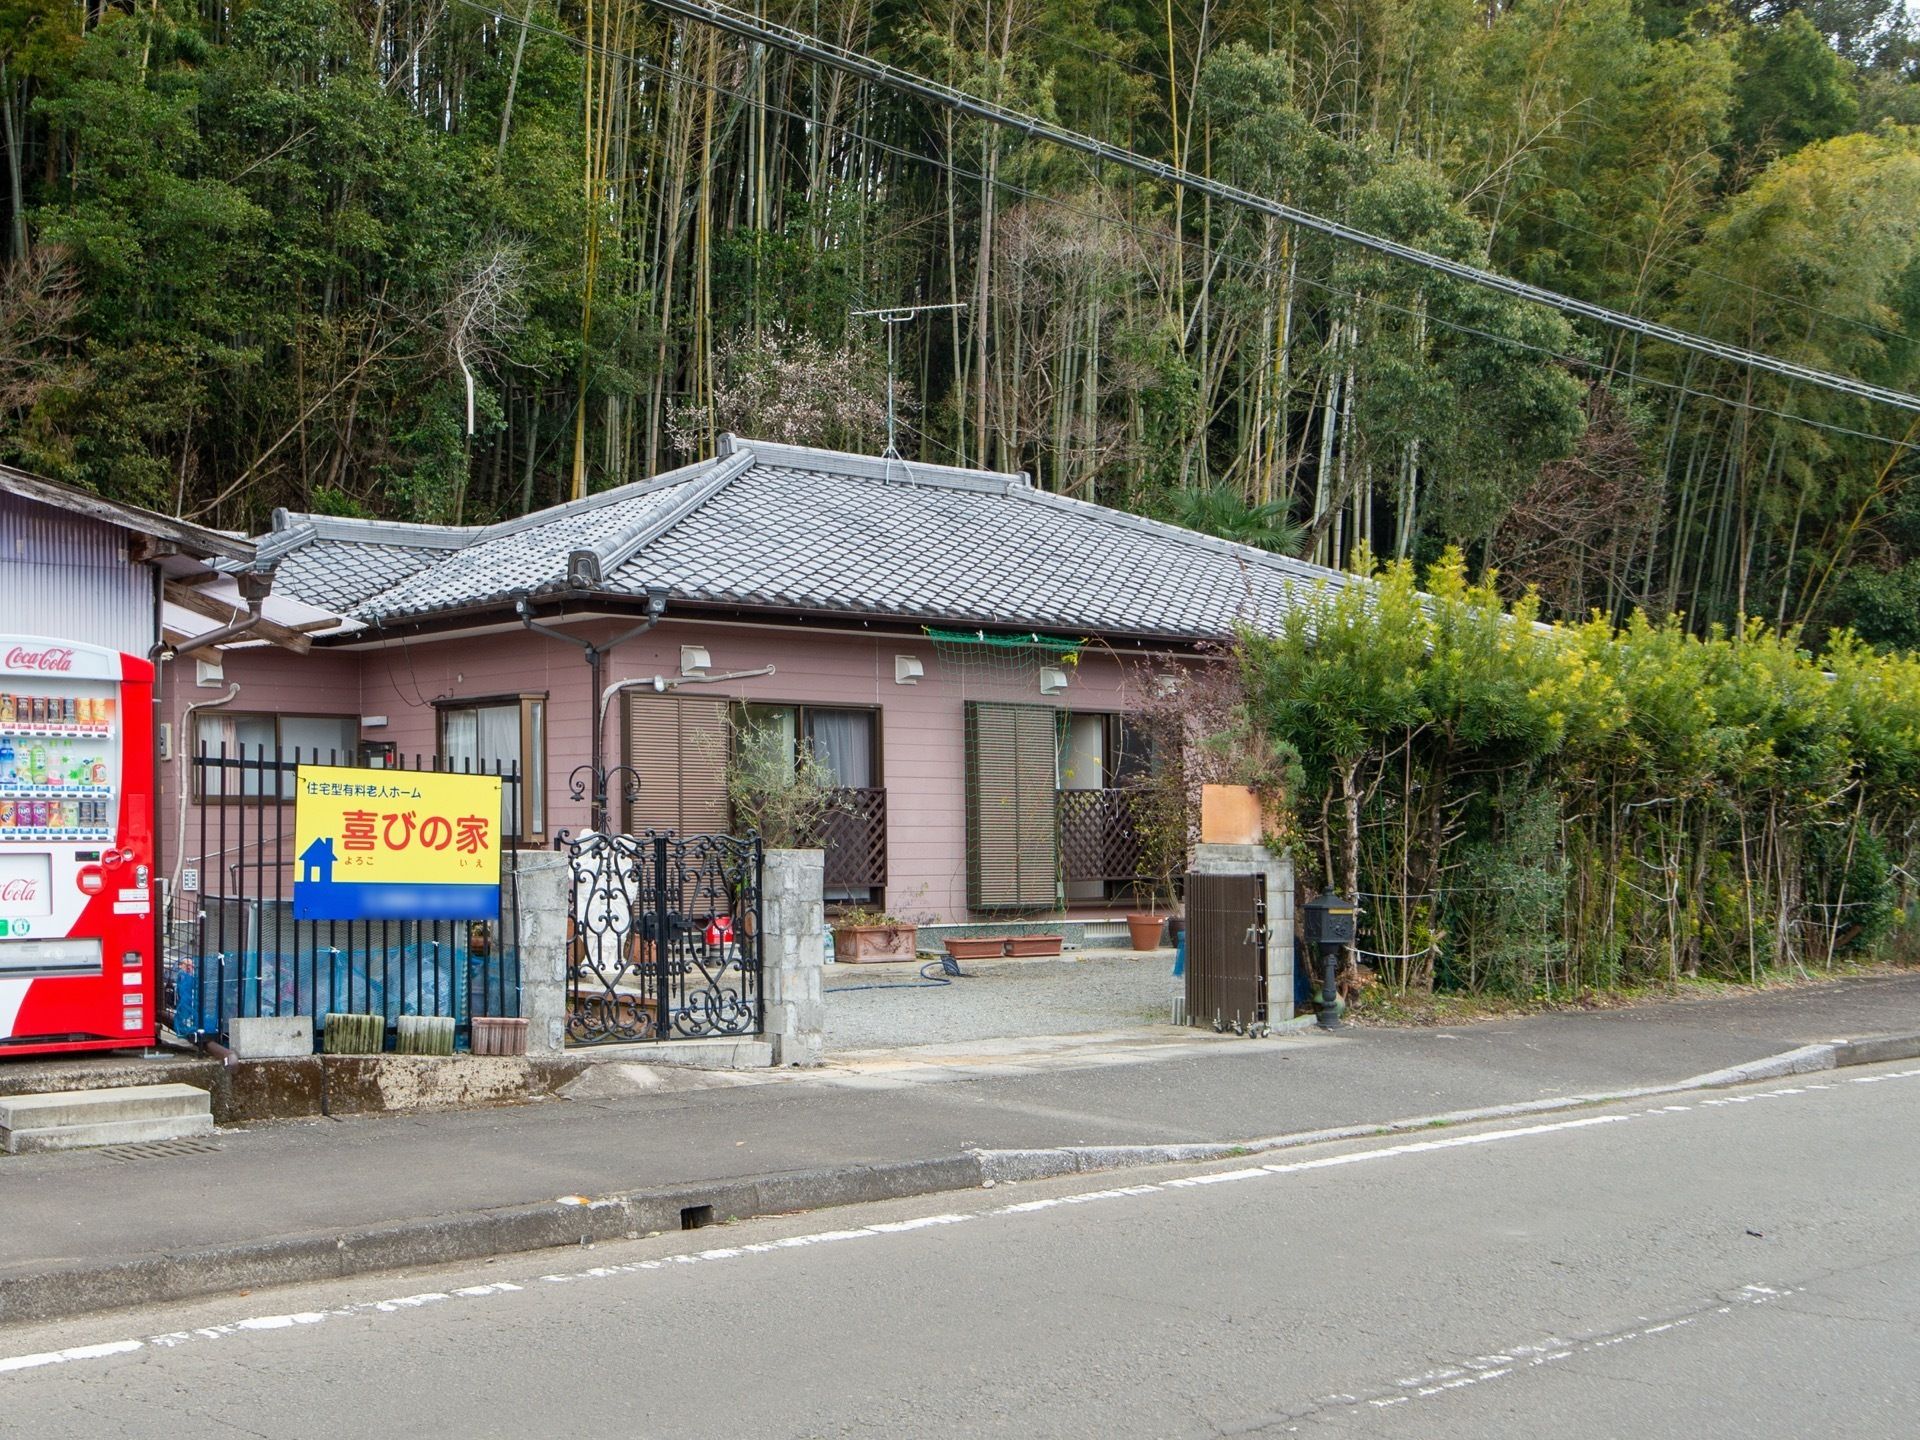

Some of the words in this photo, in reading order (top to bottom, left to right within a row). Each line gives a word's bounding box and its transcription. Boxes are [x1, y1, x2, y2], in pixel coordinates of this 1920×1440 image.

[5, 646, 75, 672] Coca-Cola
[307, 781, 422, 799] 住宅型有料老人ホーム
[341, 809, 489, 854] 喜びの家
[344, 856, 374, 866] よろこ
[459, 859, 483, 868] いえ
[0, 878, 38, 902] Cola
